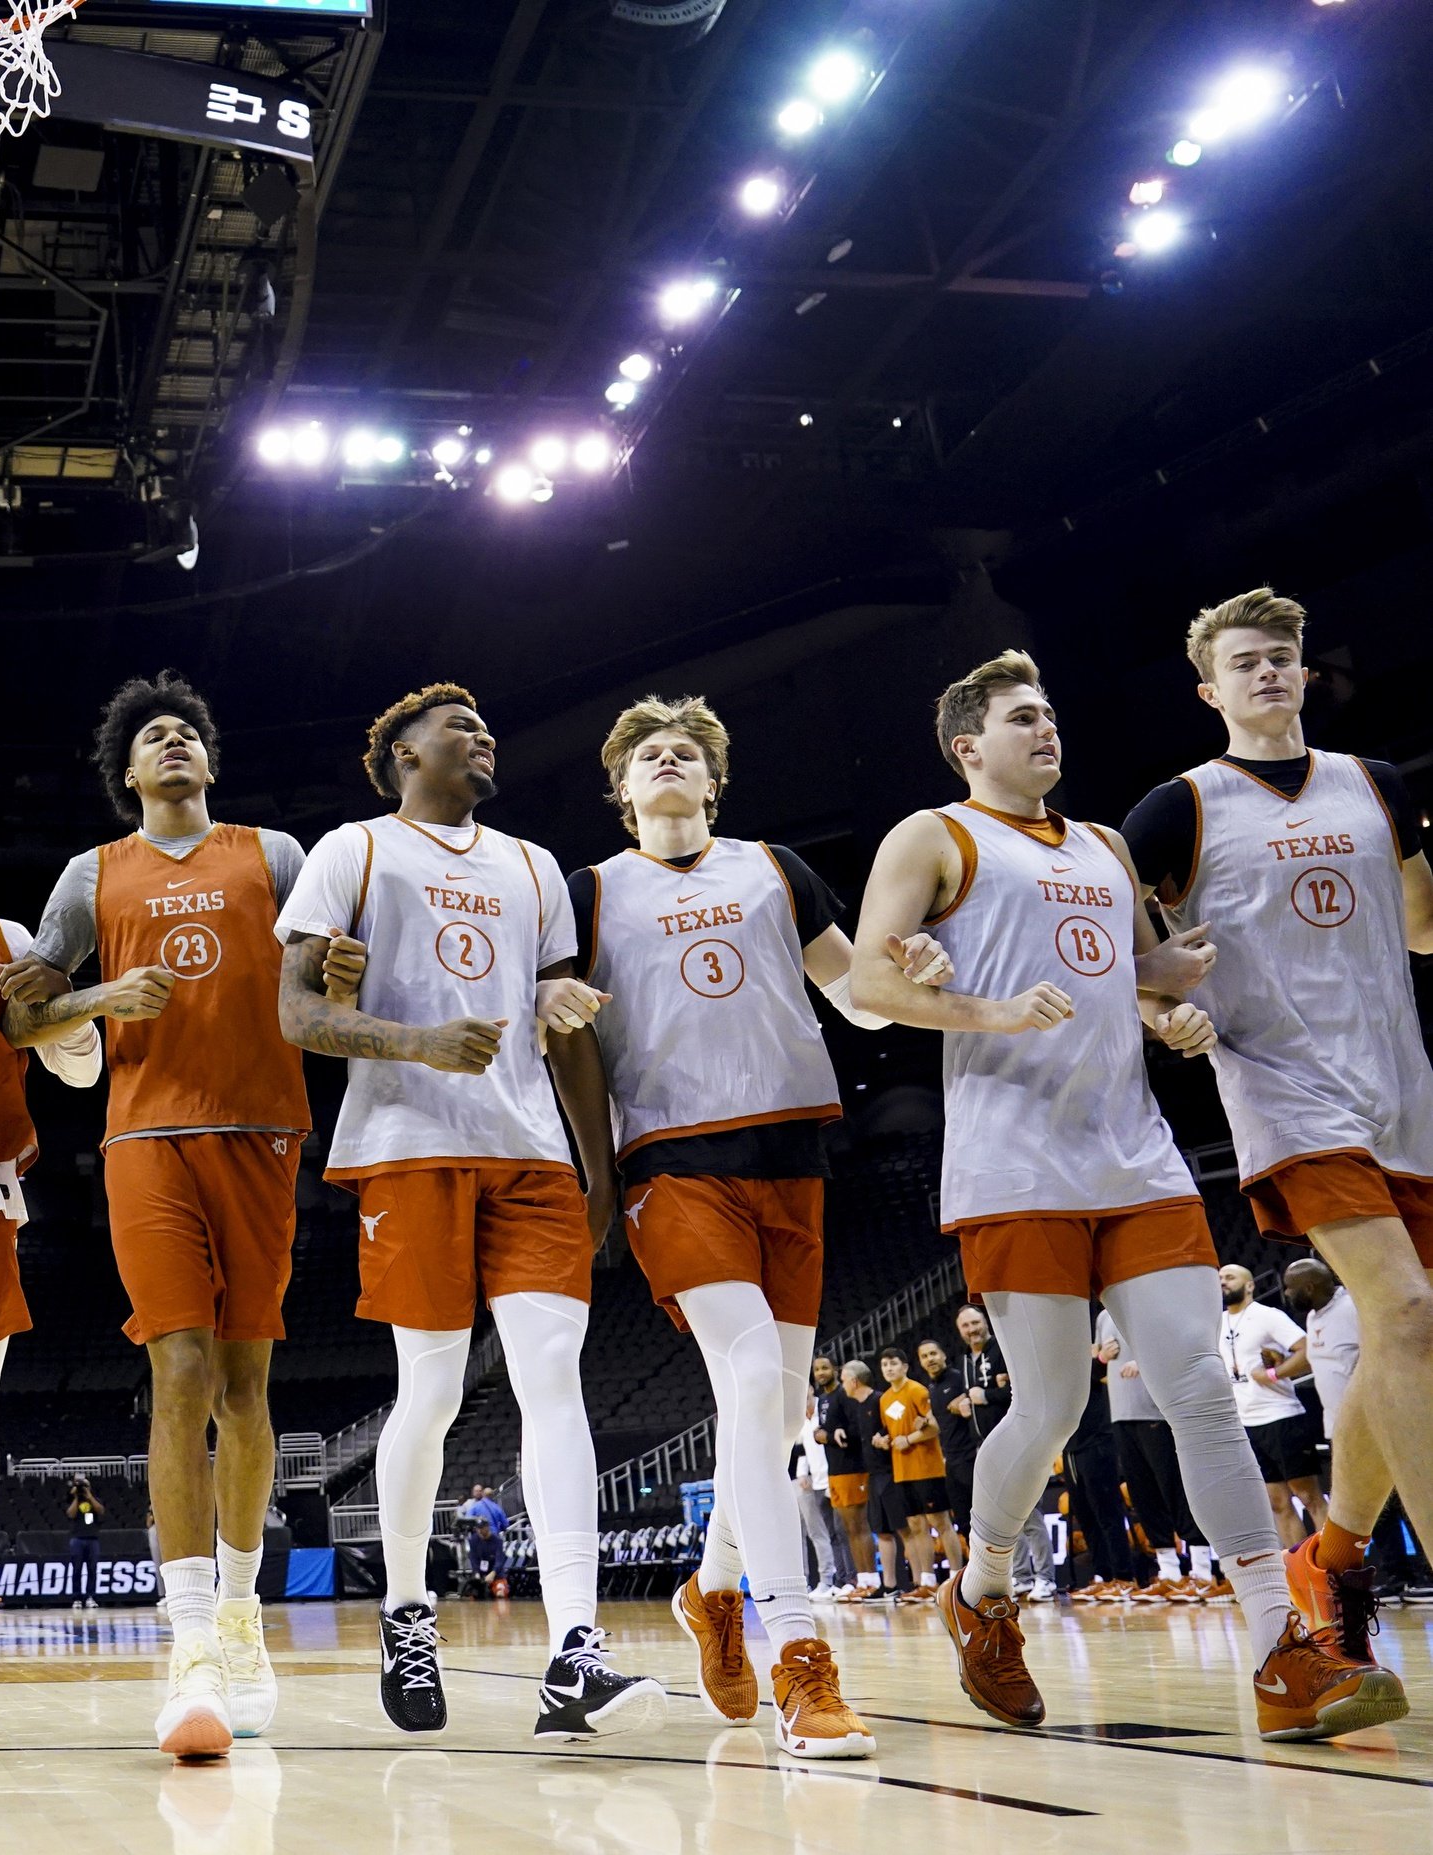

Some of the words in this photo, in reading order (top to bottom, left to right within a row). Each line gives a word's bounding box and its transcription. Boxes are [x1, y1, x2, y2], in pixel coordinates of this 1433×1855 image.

[1267, 833, 1355, 860] TEXAS
[145, 890, 225, 918] TEXAS
[425, 885, 501, 917] TEXAS
[1037, 879, 1113, 907] TEXAS
[1308, 879, 1340, 914] 12
[657, 902, 744, 936] TEXAS
[173, 933, 208, 967] 23
[459, 933, 473, 967] 2
[1070, 927, 1101, 962] 13
[702, 951, 723, 984] 3
